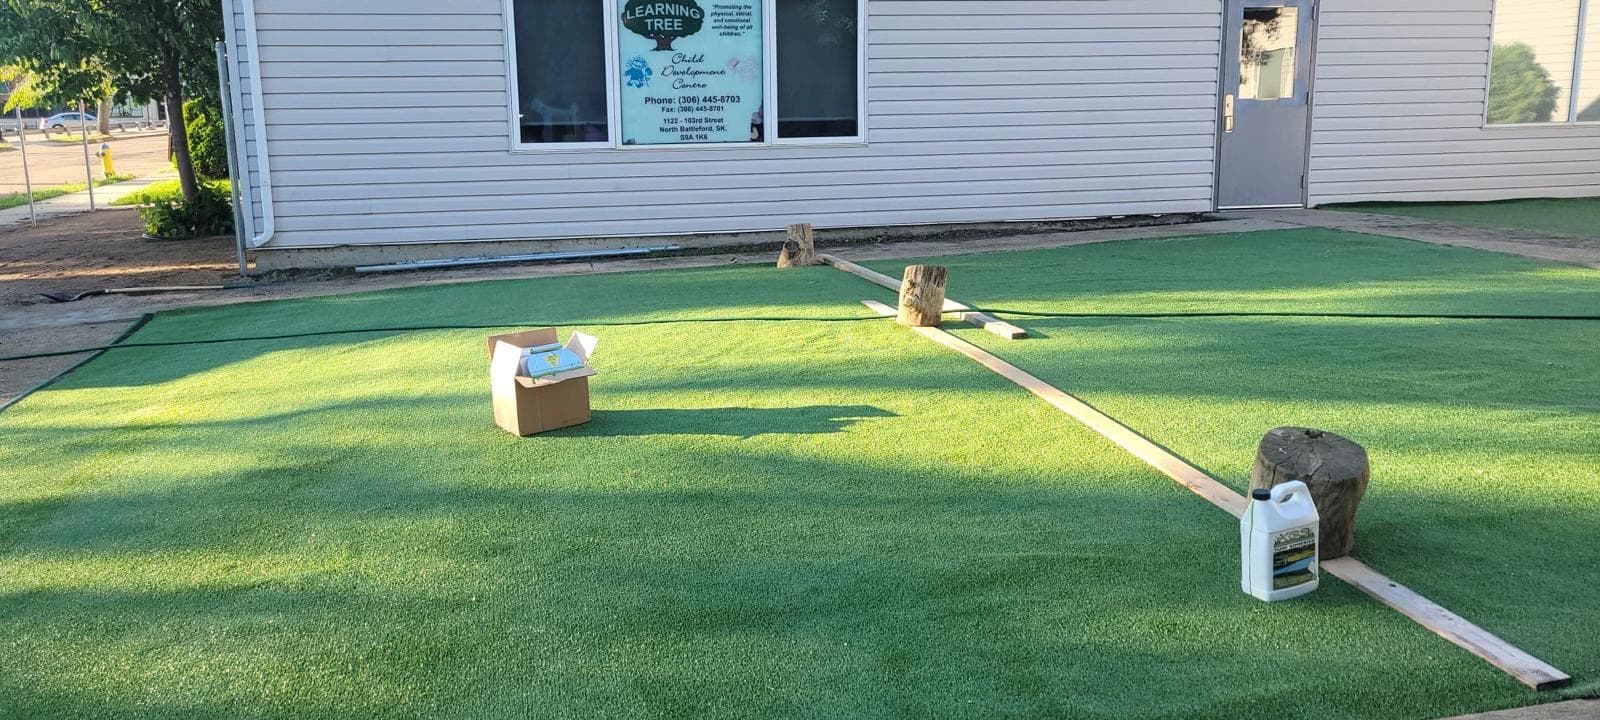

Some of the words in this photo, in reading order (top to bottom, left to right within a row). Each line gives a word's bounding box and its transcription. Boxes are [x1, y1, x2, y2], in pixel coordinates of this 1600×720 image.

[626, 3, 701, 19] LEARNING
[645, 18, 683, 31] TREE
[672, 53, 705, 64] Child
[661, 65, 726, 78] Development
[672, 78, 708, 90] Centre
[644, 96, 676, 104] Phone:
[678, 96, 700, 105] (306)
[702, 95, 741, 103] 445-8703
